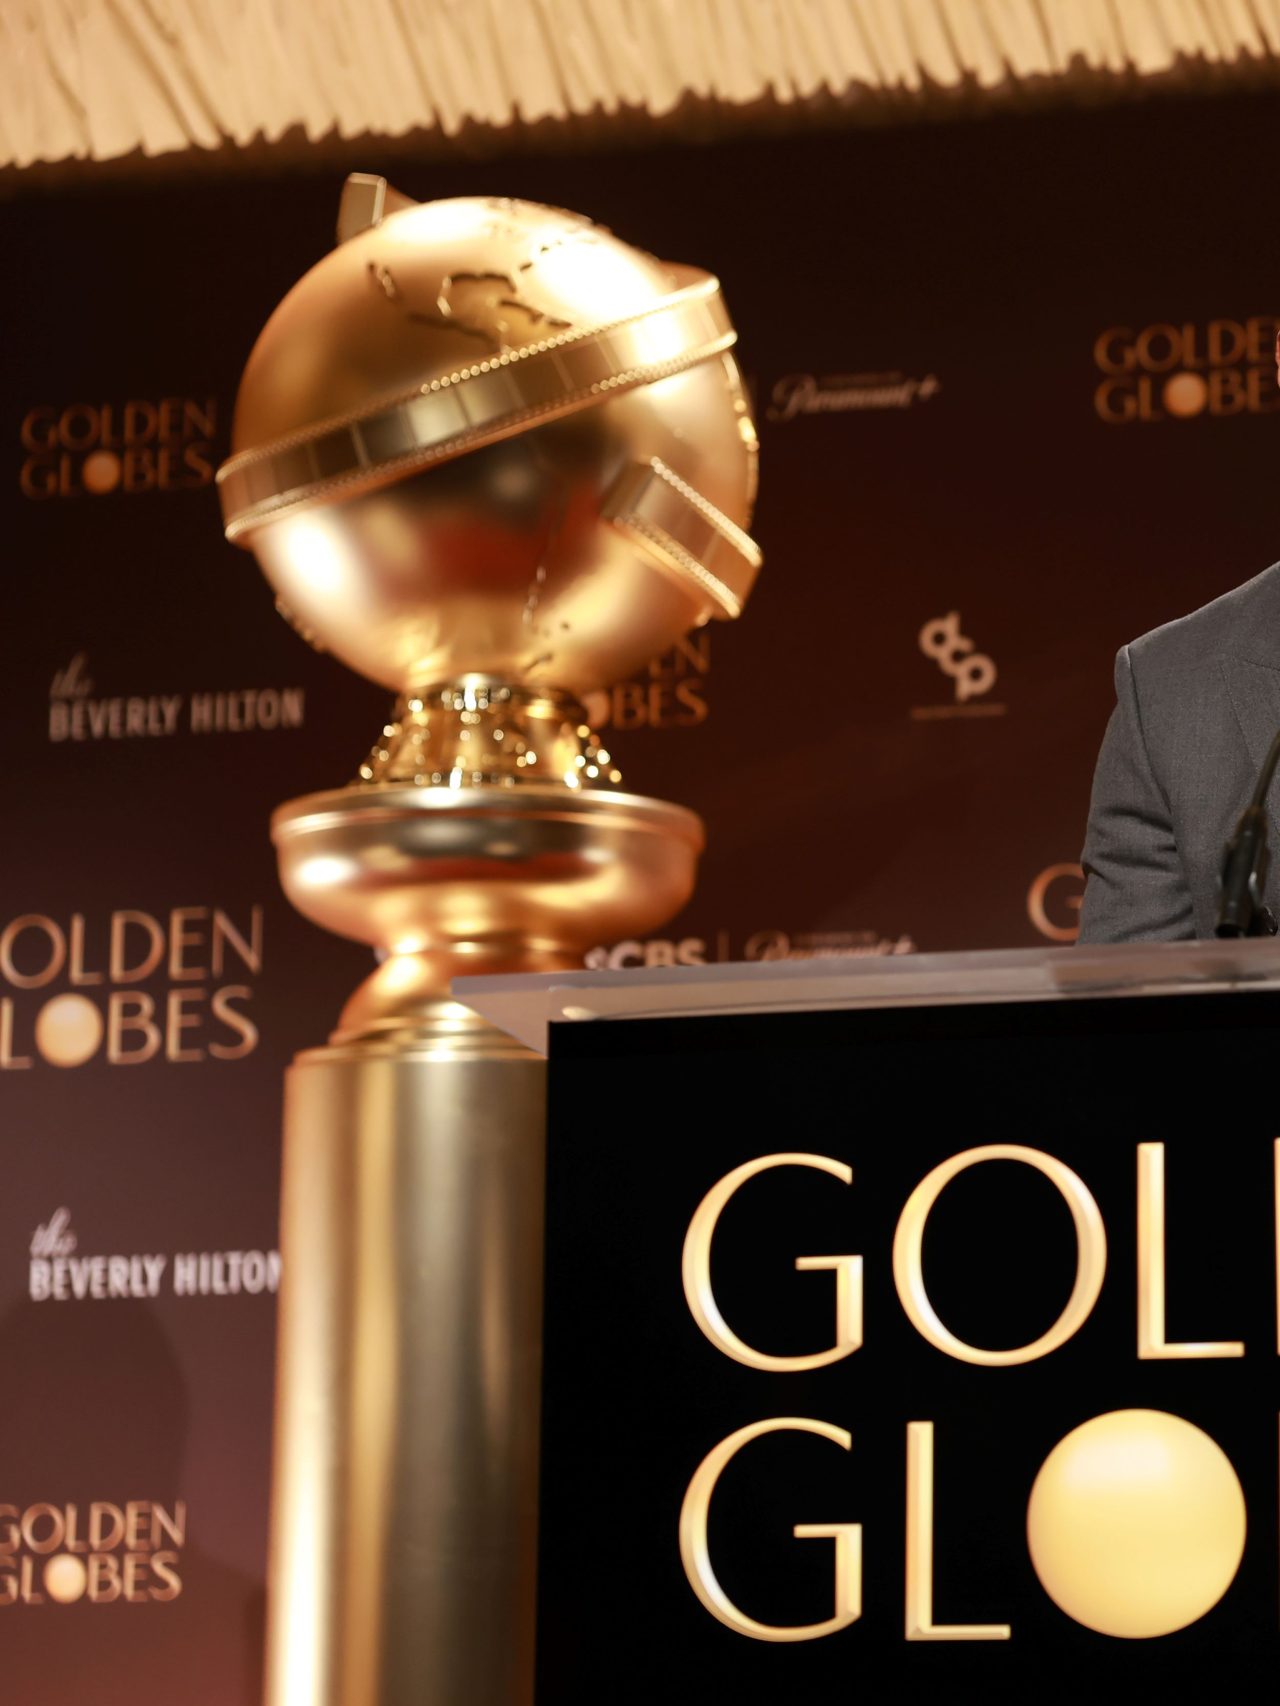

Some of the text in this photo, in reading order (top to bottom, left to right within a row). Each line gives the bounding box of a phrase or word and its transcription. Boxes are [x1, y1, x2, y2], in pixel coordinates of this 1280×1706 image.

[20, 397, 215, 454] GOLDEN
[20, 442, 215, 500] GLOBES
[48, 688, 304, 742] BEVERLY HILTON
[30, 1249, 281, 1302] BEVERLY HILTON
